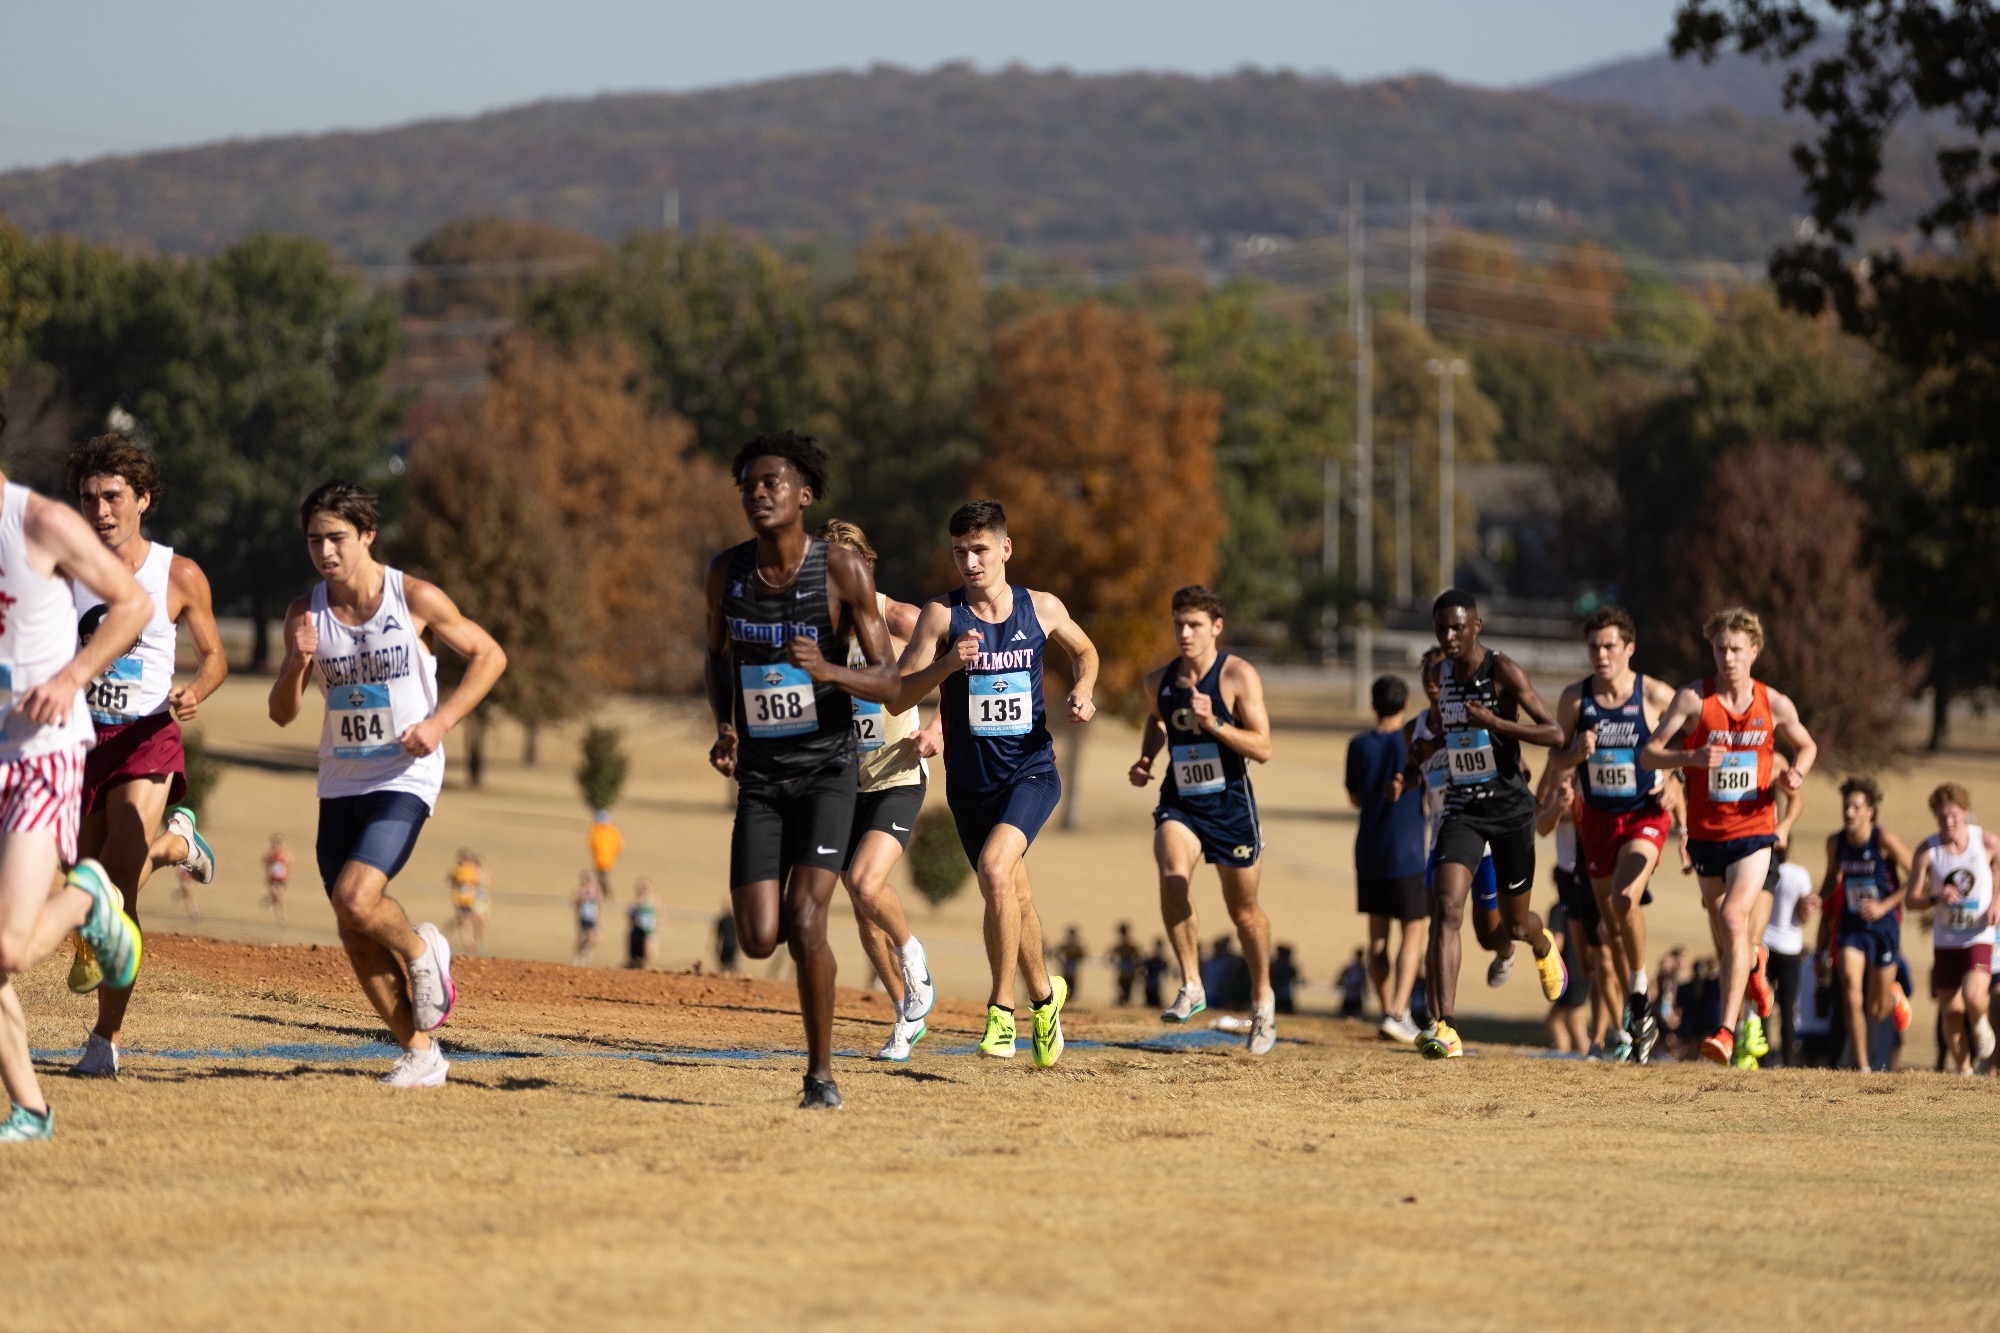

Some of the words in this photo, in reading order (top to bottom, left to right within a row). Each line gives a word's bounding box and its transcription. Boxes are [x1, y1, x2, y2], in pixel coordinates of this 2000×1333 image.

[726, 616, 819, 648] Memphis
[318, 655, 358, 689] NORTH
[360, 644, 410, 683] FLORIDA
[86, 682, 129, 710] 265
[754, 692, 804, 721] 368
[980, 697, 1022, 722] 135
[340, 714, 385, 743] 464
[1182, 763, 1215, 784] 300
[1455, 751, 1487, 773] 409
[1596, 767, 1627, 786] 495
[1717, 771, 1750, 789] 580
